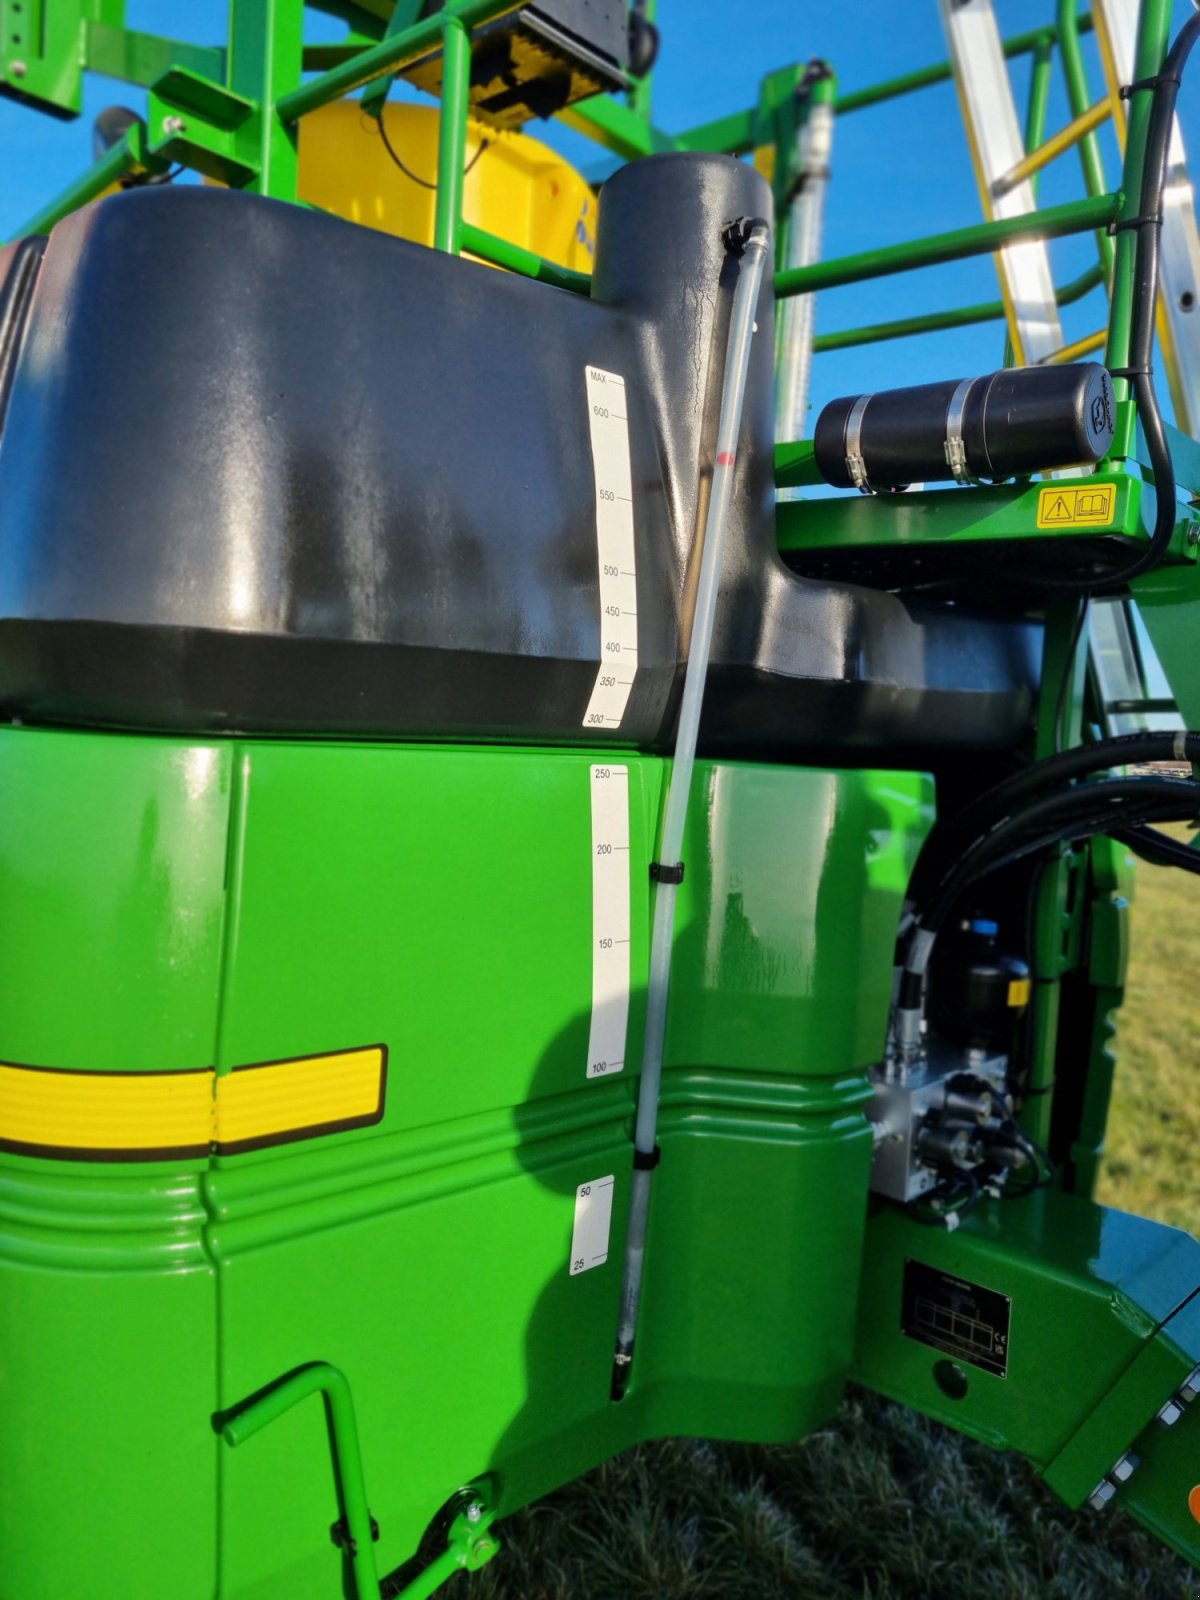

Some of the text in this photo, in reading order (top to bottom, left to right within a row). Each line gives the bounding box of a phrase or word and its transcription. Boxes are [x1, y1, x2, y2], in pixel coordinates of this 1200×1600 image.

[593, 405, 609, 418] 600
[599, 489, 615, 501] 550
[603, 564, 619, 577] 500
[605, 605, 620, 617] 450
[605, 642, 621, 653] 400
[599, 676, 616, 687] 350
[587, 714, 604, 724] 300
[595, 768, 611, 779] 250
[596, 843, 612, 855] 200
[599, 937, 613, 949] 150
[592, 1061, 607, 1073] 100
[580, 1186, 592, 1198] 50
[573, 1258, 585, 1271] 25
